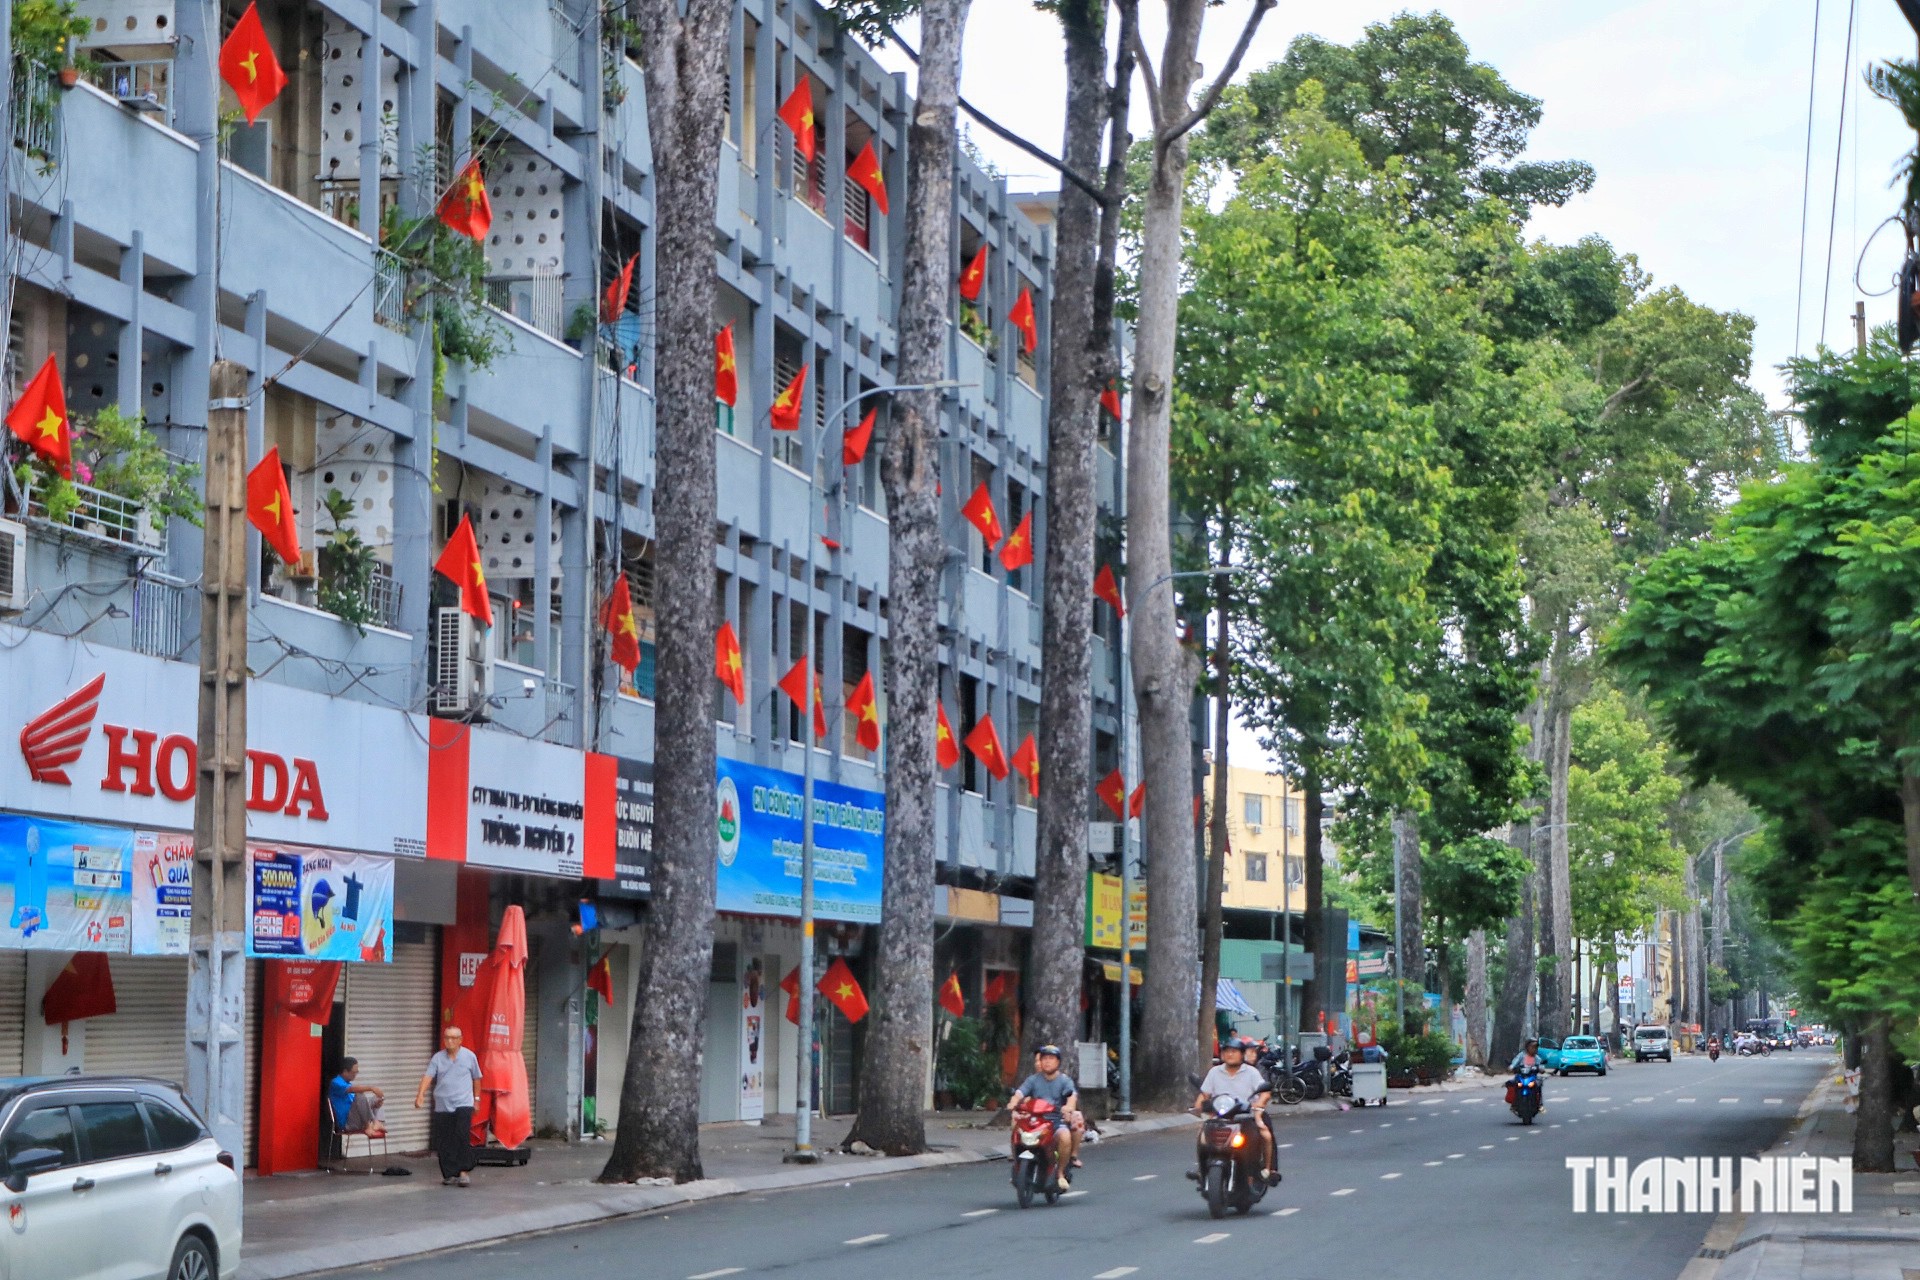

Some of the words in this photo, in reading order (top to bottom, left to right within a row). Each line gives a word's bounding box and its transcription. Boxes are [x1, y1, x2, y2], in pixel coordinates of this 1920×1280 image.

[101, 723, 329, 821] HODA
[567, 832, 575, 856] 2
[617, 826, 639, 849] BUÔN
[640, 829, 652, 852] MÊ
